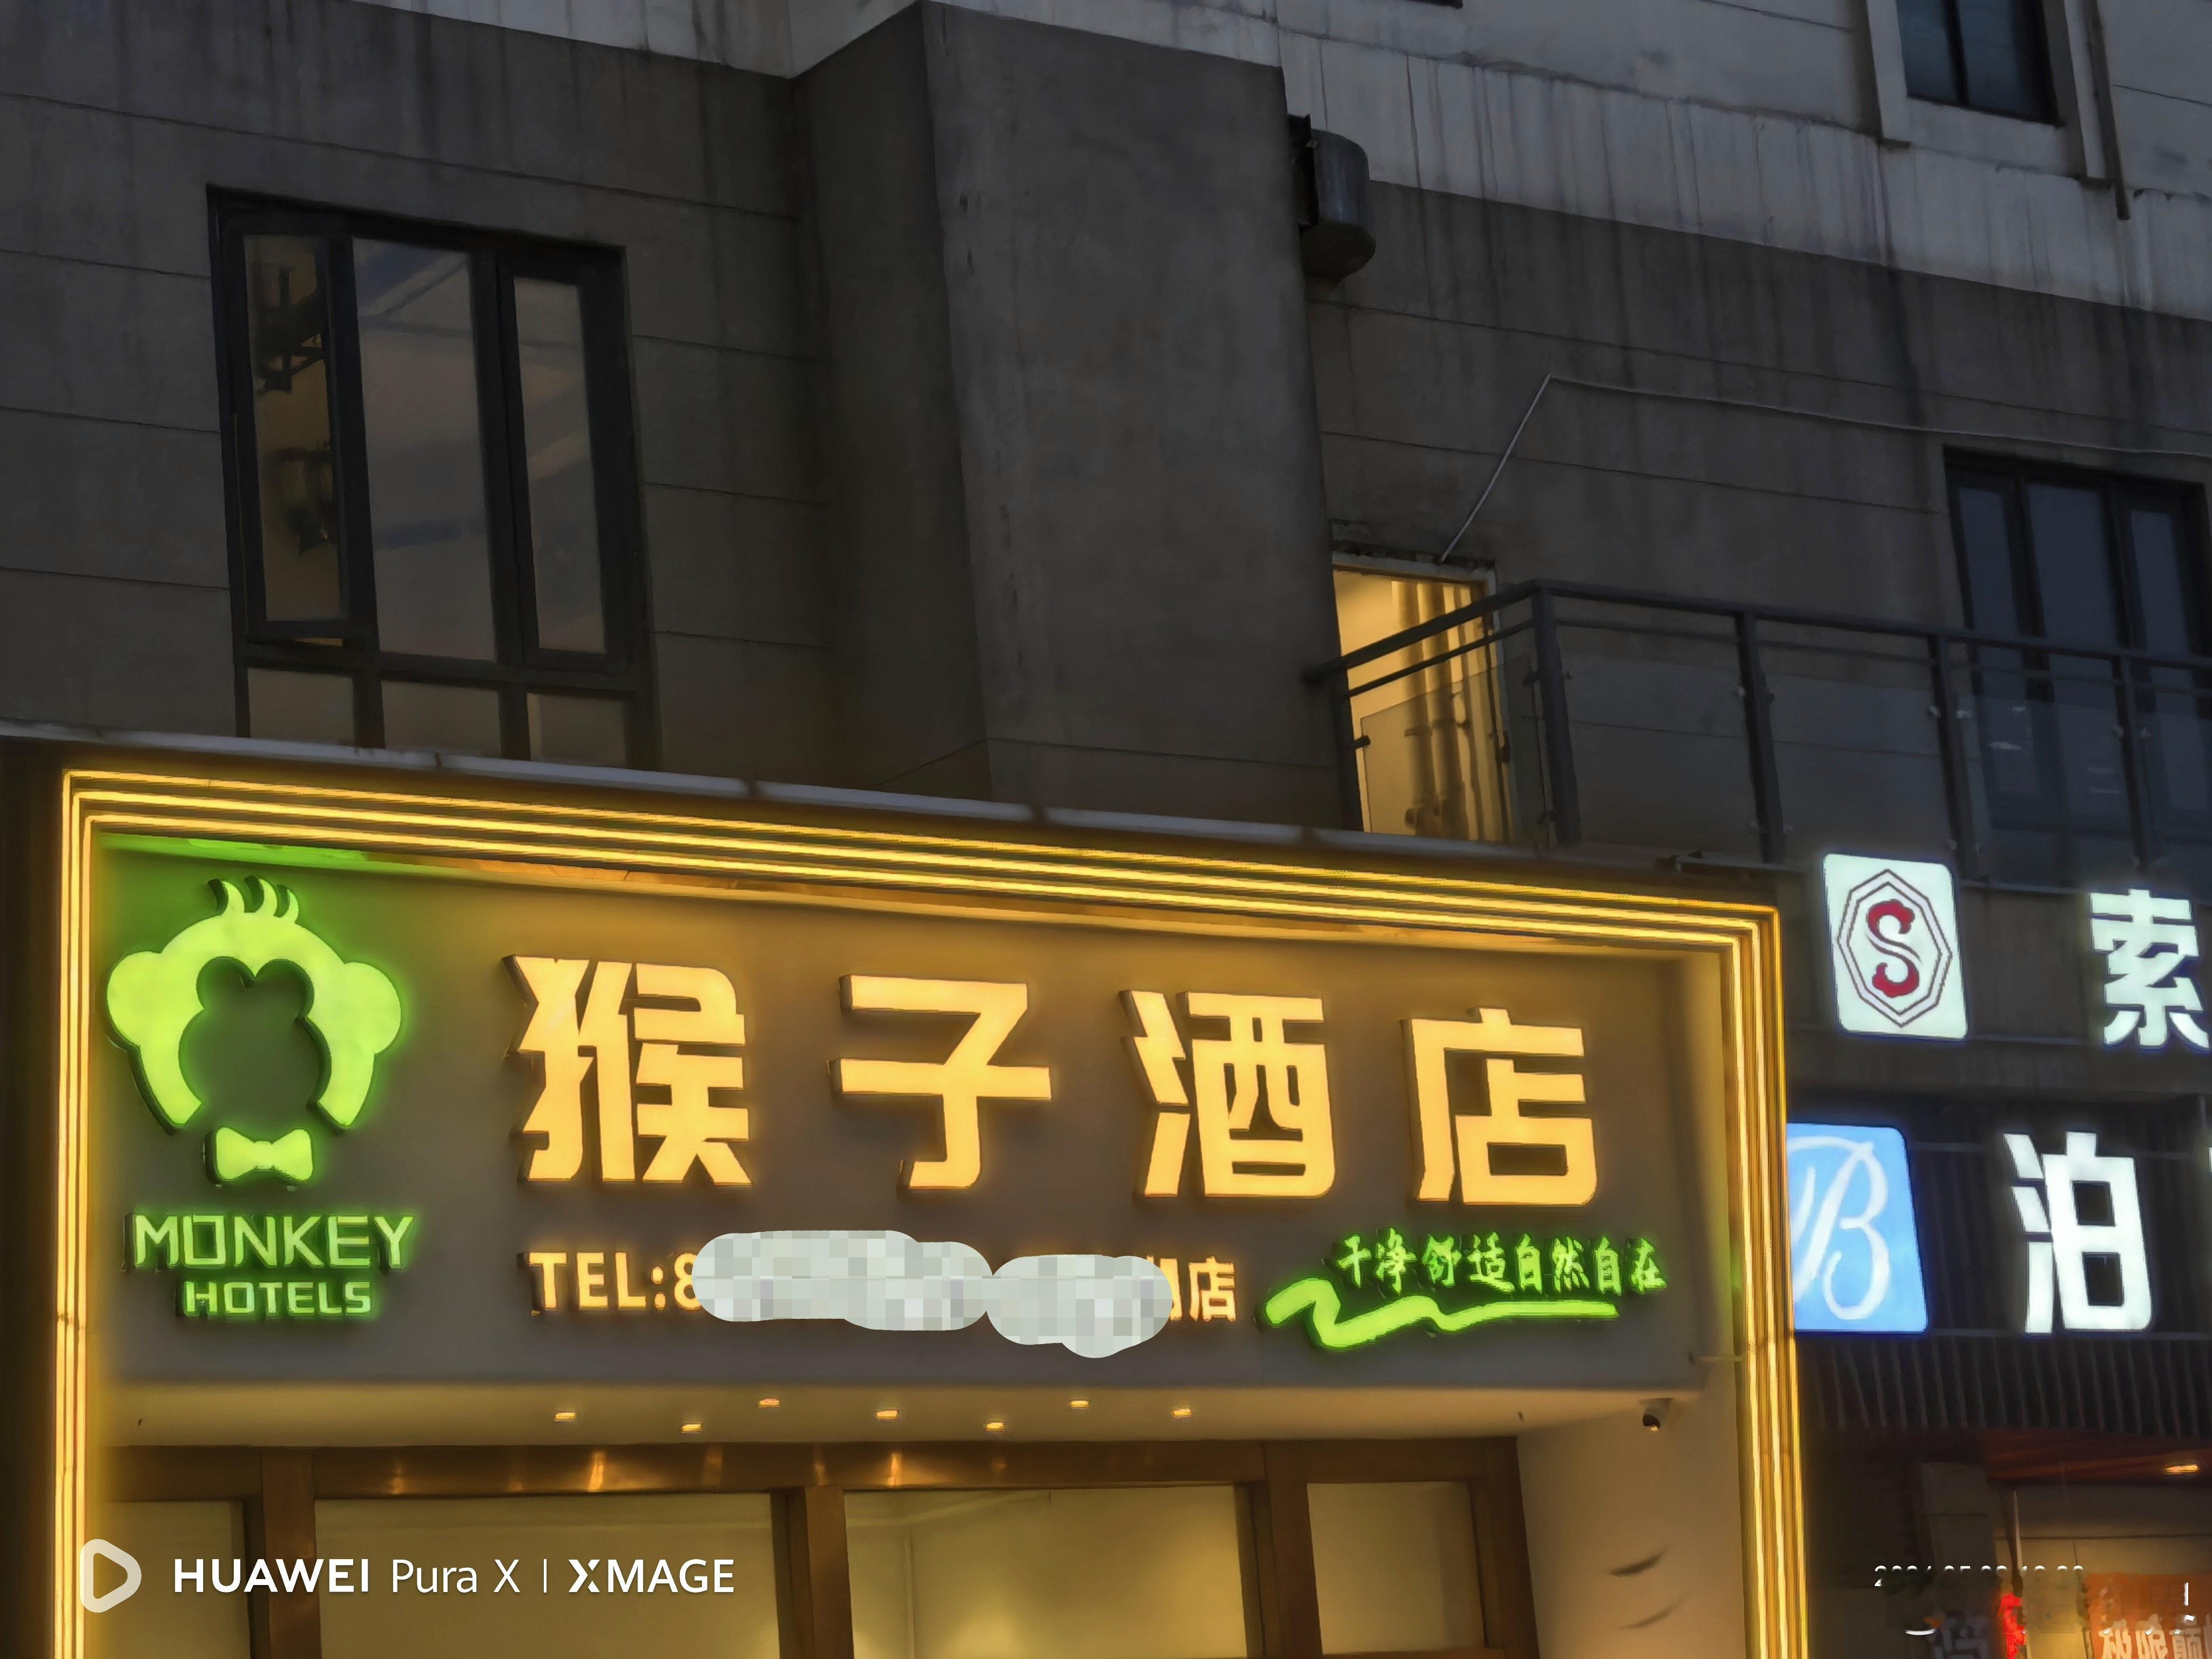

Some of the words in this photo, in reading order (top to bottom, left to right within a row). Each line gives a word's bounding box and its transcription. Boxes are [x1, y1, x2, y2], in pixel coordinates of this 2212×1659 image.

[2090, 888, 2210, 1049] 索
[515, 956, 1597, 1206] 猴子酒店
[133, 1213, 415, 1269] MONKEY
[1336, 1227, 1667, 1294] 干净舒适自然自在
[2003, 1131, 2152, 1334] 泊
[184, 1281, 372, 1316] HOTELS
